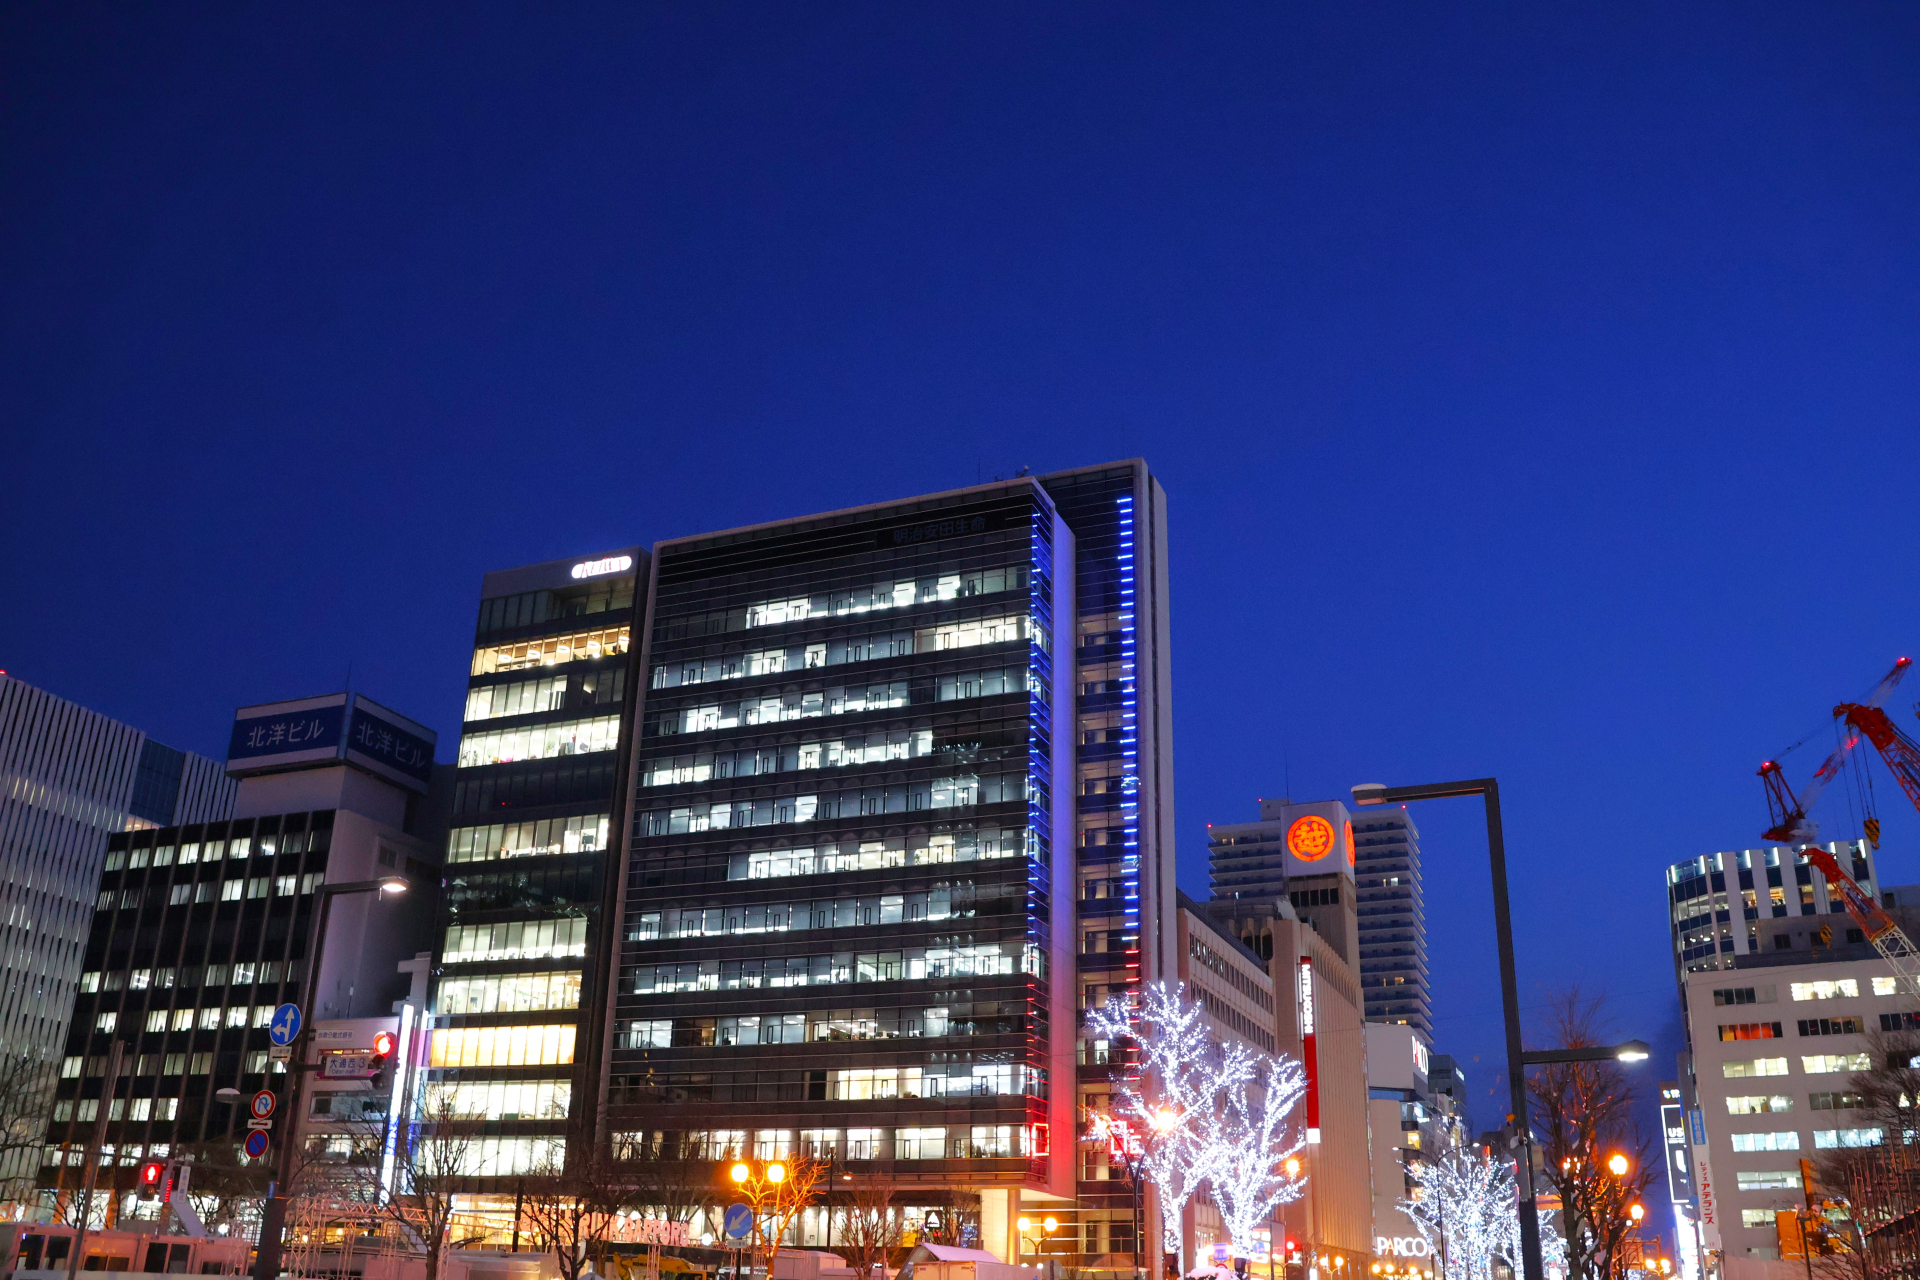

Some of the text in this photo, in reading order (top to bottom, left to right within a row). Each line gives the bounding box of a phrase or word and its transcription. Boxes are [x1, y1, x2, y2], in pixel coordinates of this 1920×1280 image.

[894, 516, 985, 542] 明治安田生命
[247, 719, 324, 748] 北洋ビル
[356, 722, 425, 769] 北洋ビル
[1301, 963, 1314, 1034] MITSUKOSHI
[1411, 1035, 1429, 1076] PARCO
[624, 1217, 690, 1247] SAPPORO
[1376, 1236, 1428, 1257] PARCO
